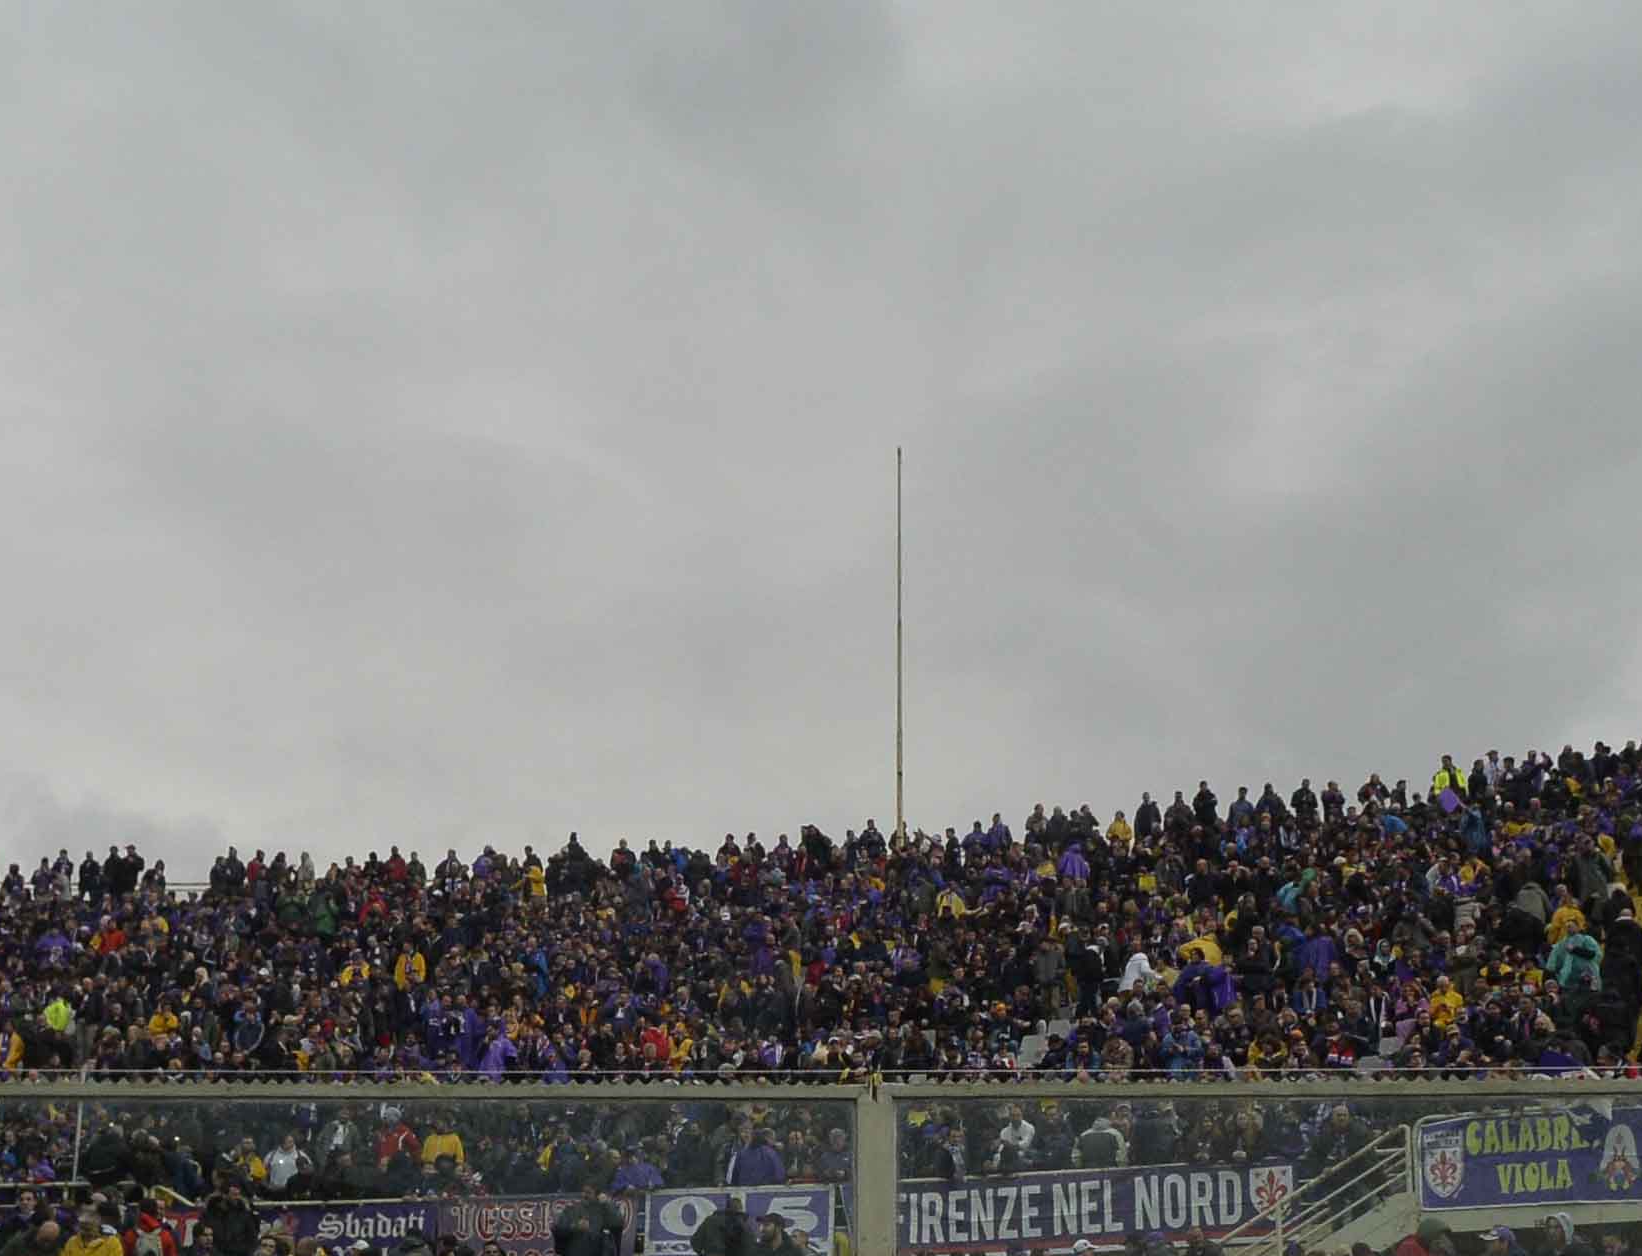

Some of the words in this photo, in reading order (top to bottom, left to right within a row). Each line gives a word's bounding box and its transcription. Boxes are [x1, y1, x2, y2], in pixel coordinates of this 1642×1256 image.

[1466, 1113, 1600, 1156] CALABR
[1495, 1159, 1574, 1194] VIOLA
[1053, 1180, 1124, 1236] NEL
[1133, 1170, 1244, 1231] NORD
